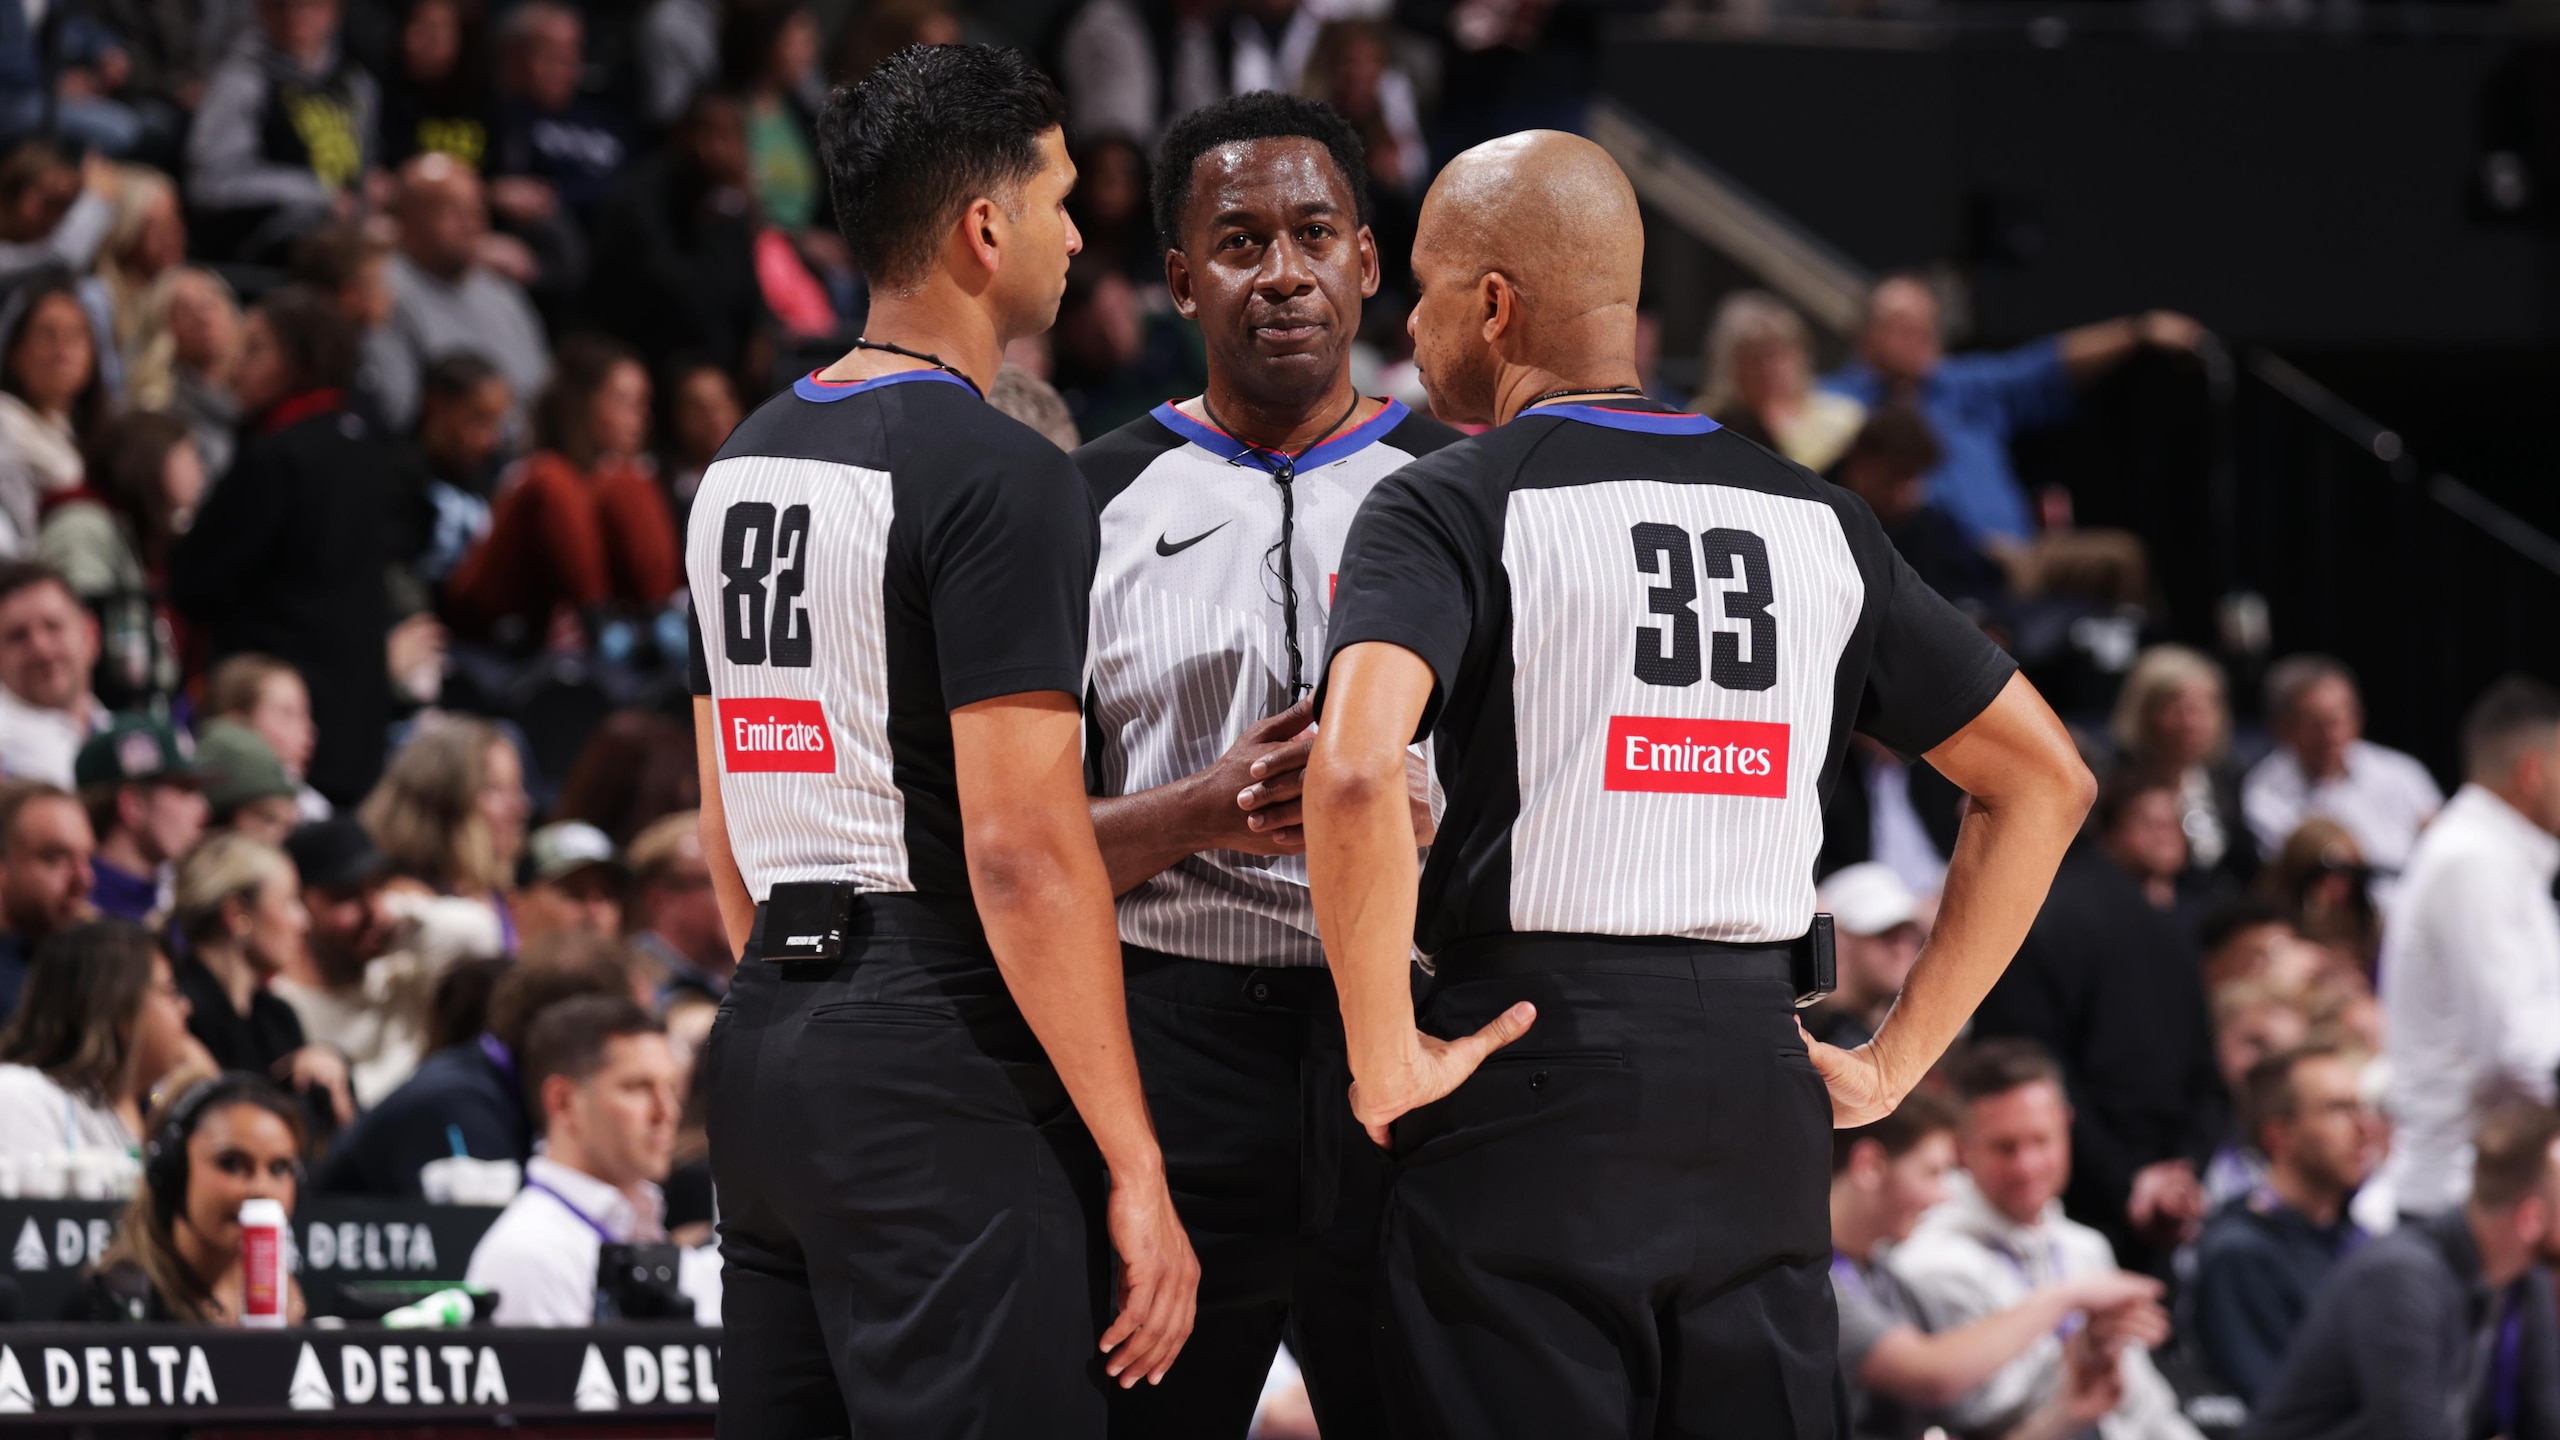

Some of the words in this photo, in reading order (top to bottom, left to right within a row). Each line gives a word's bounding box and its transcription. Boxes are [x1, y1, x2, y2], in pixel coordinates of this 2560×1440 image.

[720, 501, 813, 668] 82
[1630, 521, 1777, 692] 33
[732, 715, 825, 752] Emirates
[1625, 735, 1772, 777] Emirates
[306, 1220, 438, 1271] DELTA
[43, 1345, 219, 1407] DELTA
[340, 1344, 509, 1405] DELTA
[623, 1344, 721, 1404] DEL
